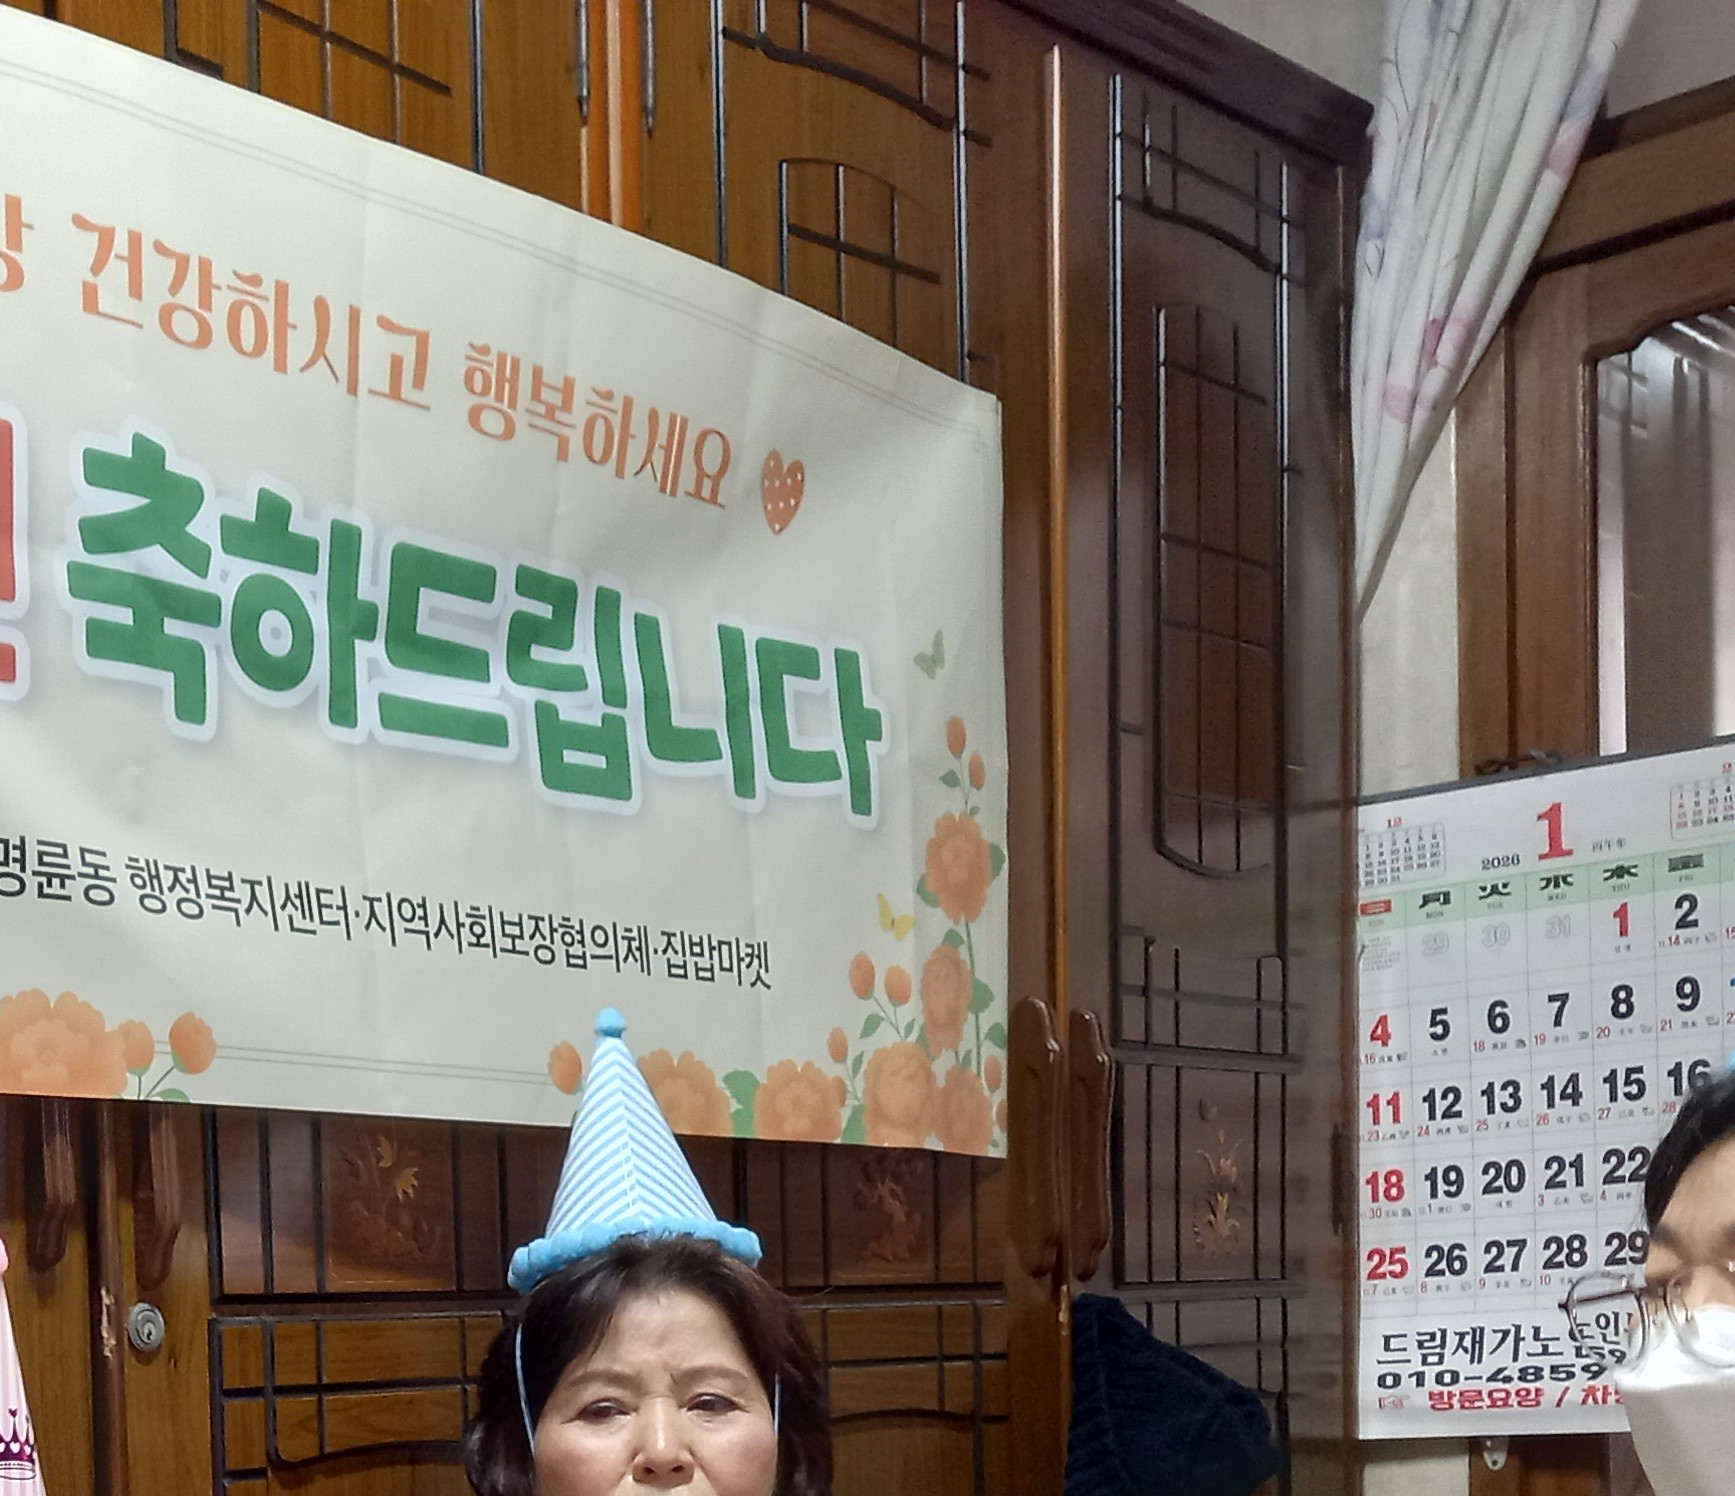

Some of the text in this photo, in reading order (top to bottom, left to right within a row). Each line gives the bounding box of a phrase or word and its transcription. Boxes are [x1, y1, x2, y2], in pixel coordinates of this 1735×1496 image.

[71, 212, 431, 412] 건강하시고
[463, 341, 733, 509] 행복하세요
[66, 432, 883, 816] 축하드립니다
[1537, 802, 1574, 860] 1
[1478, 881, 1512, 900] 火
[1539, 873, 1574, 891] 水
[1481, 854, 1521, 871] 2026
[1613, 902, 1629, 937] 1
[1674, 893, 1699, 931] 2
[1369, 976, 1701, 1047] 4 5 6 7 8 9
[1366, 1058, 1713, 1126] 11 12 13 14 15 16
[1365, 1146, 1651, 1204] 18 19 20 21 22
[1366, 1230, 1649, 1281] 25 26 27 28 29
[1428, 1386, 1544, 1411] 방문요양
